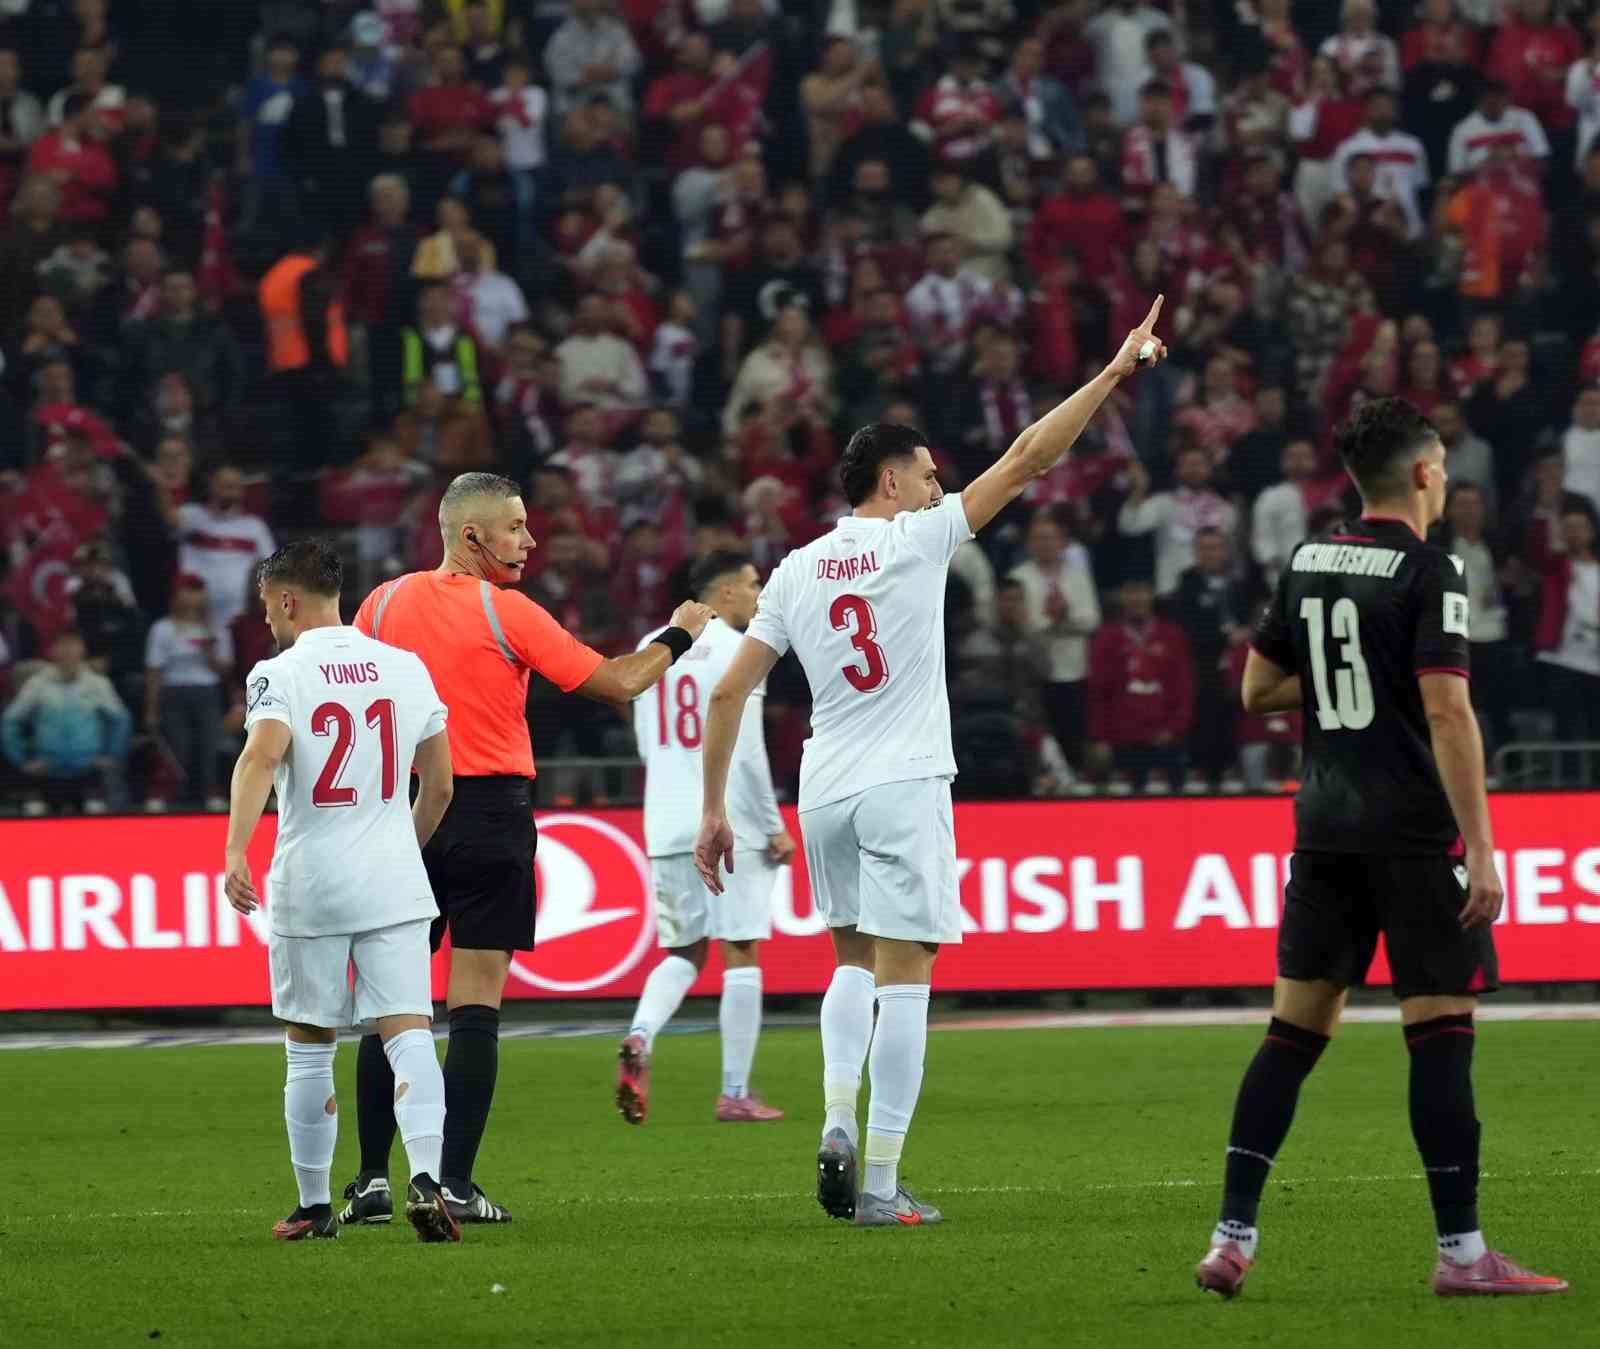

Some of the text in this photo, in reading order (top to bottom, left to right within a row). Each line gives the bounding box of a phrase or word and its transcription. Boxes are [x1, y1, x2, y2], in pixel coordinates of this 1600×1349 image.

[319, 662, 379, 685] YUNUS
[829, 593, 890, 694] 3
[1299, 597, 1376, 731] 13
[310, 697, 399, 808] 21
[656, 673, 702, 749] 18
